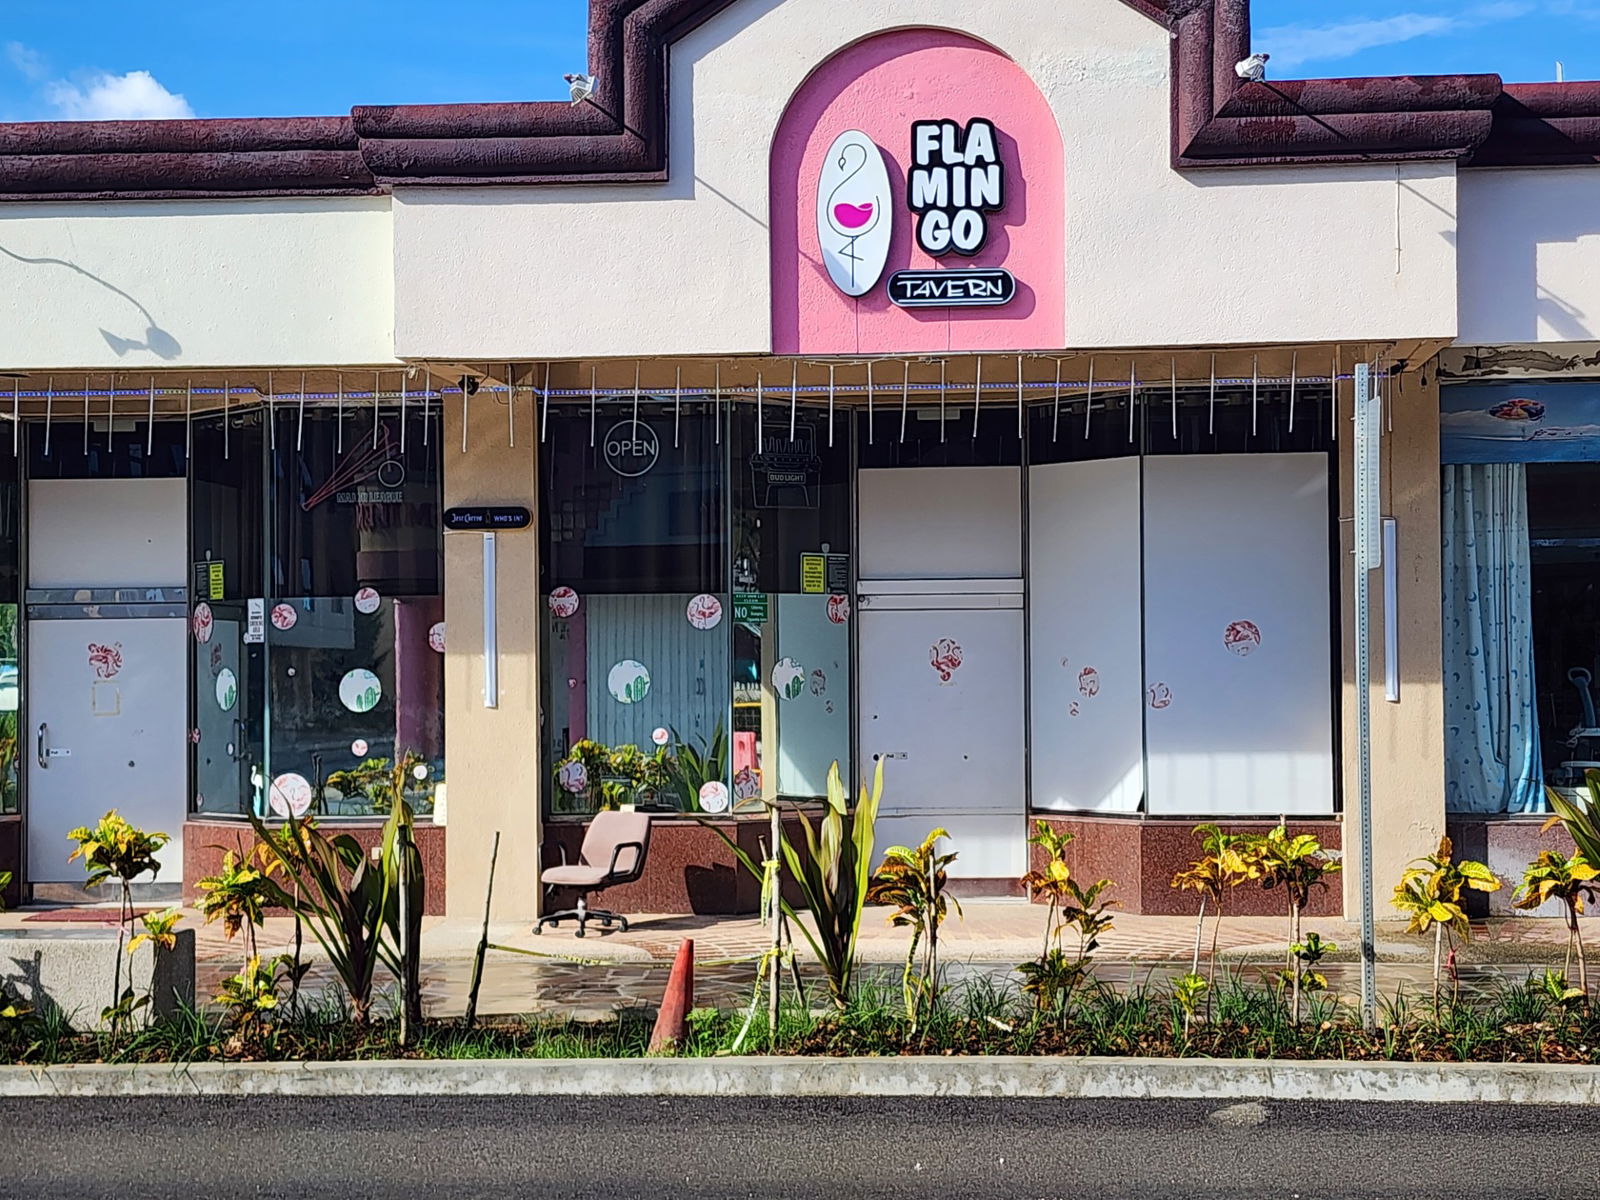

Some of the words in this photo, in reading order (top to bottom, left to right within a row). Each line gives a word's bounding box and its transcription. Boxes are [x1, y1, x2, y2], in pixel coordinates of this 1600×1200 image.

[914, 122, 997, 166] FLA
[911, 164, 1001, 208] MIN
[919, 208, 985, 252] GO
[896, 278, 1004, 298] TAVERN
[606, 439, 656, 457] OPEN
[785, 474, 804, 482] LIGHT
[734, 606, 748, 618] NO
